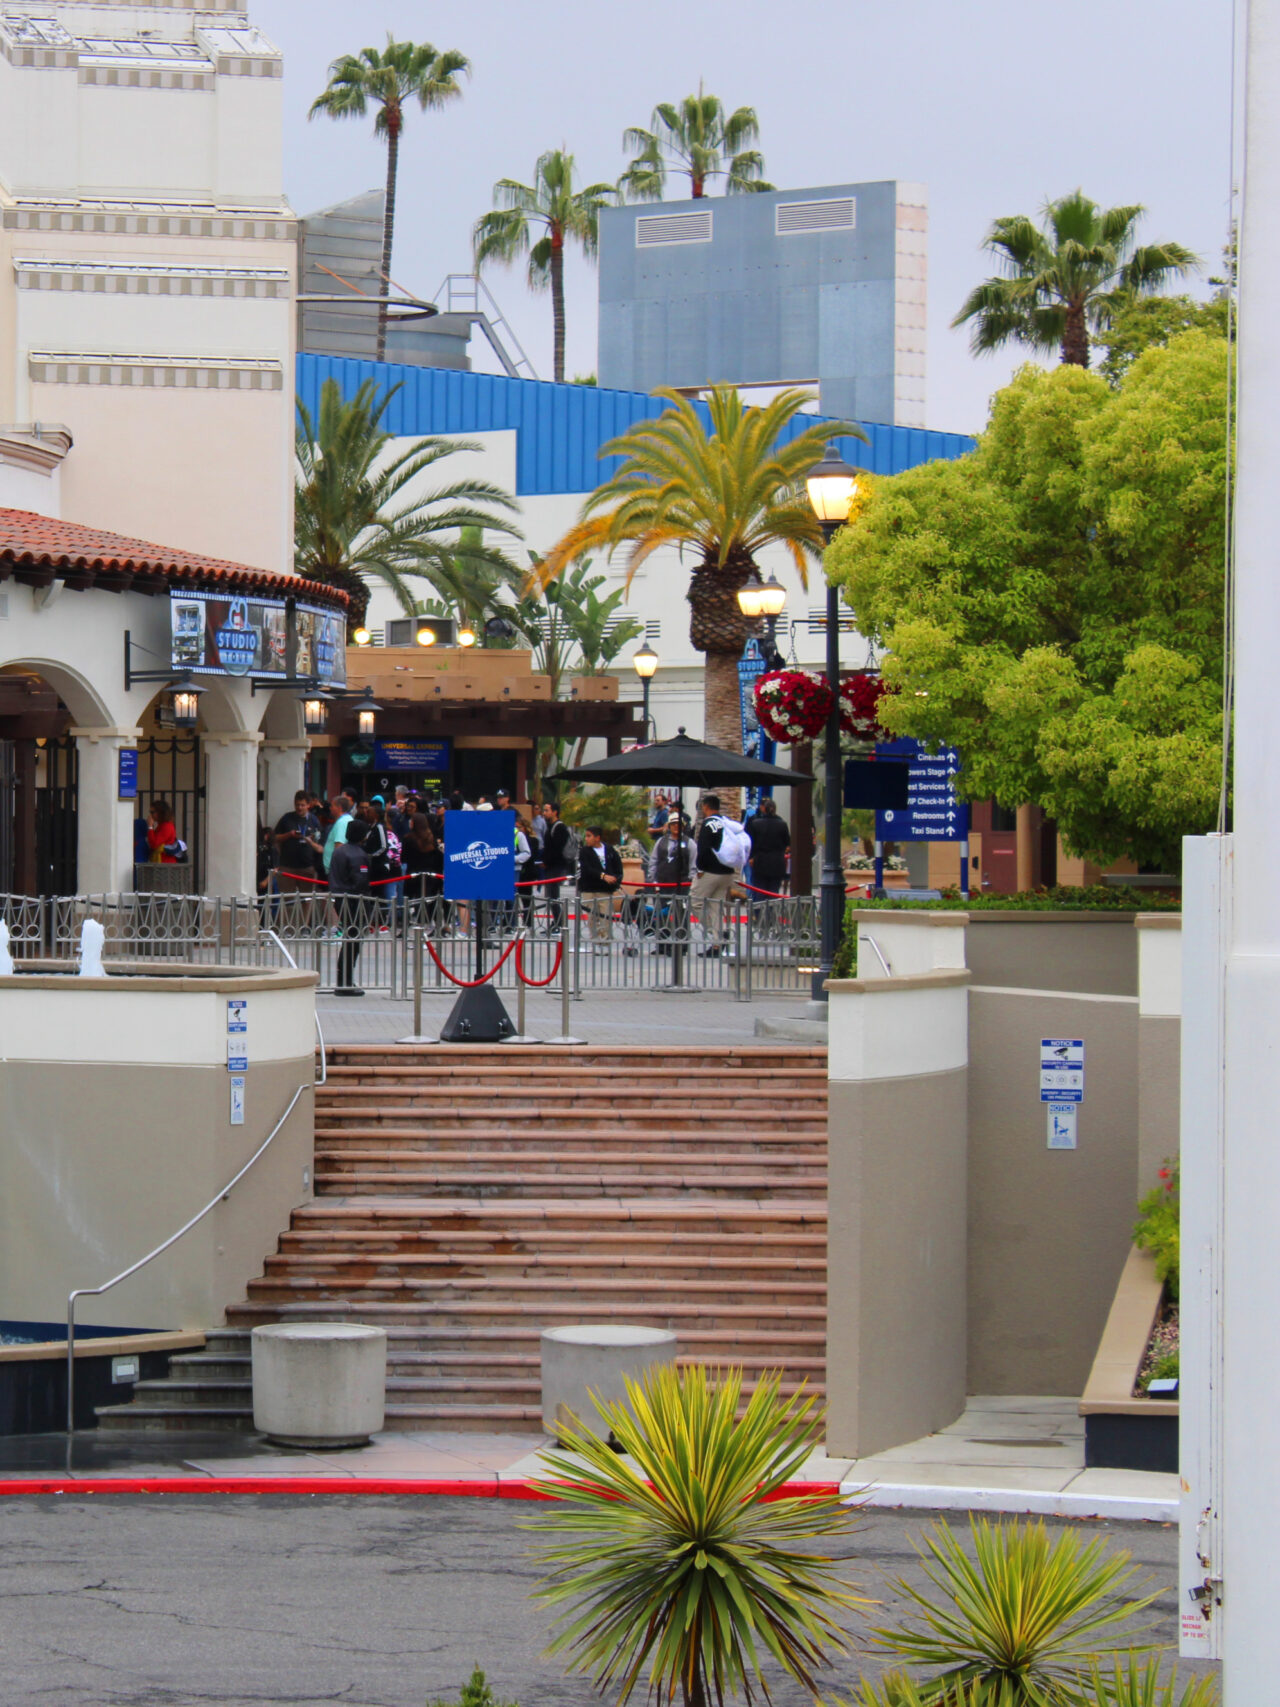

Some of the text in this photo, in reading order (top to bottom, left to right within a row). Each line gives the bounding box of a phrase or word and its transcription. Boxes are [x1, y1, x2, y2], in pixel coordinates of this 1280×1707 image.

[217, 631, 257, 650] STUDIO
[738, 660, 766, 671] STUDIO
[908, 768, 946, 777] owers Stage
[381, 778, 389, 789] 9
[918, 783, 946, 791] Services
[917, 797, 945, 805] Check-In
[912, 812, 946, 820] Restrooms
[911, 827, 945, 835] Taxi Stand
[450, 847, 509, 862] UNIVERSAL STUDIOS
[1049, 1104, 1075, 1112] NOTICE
